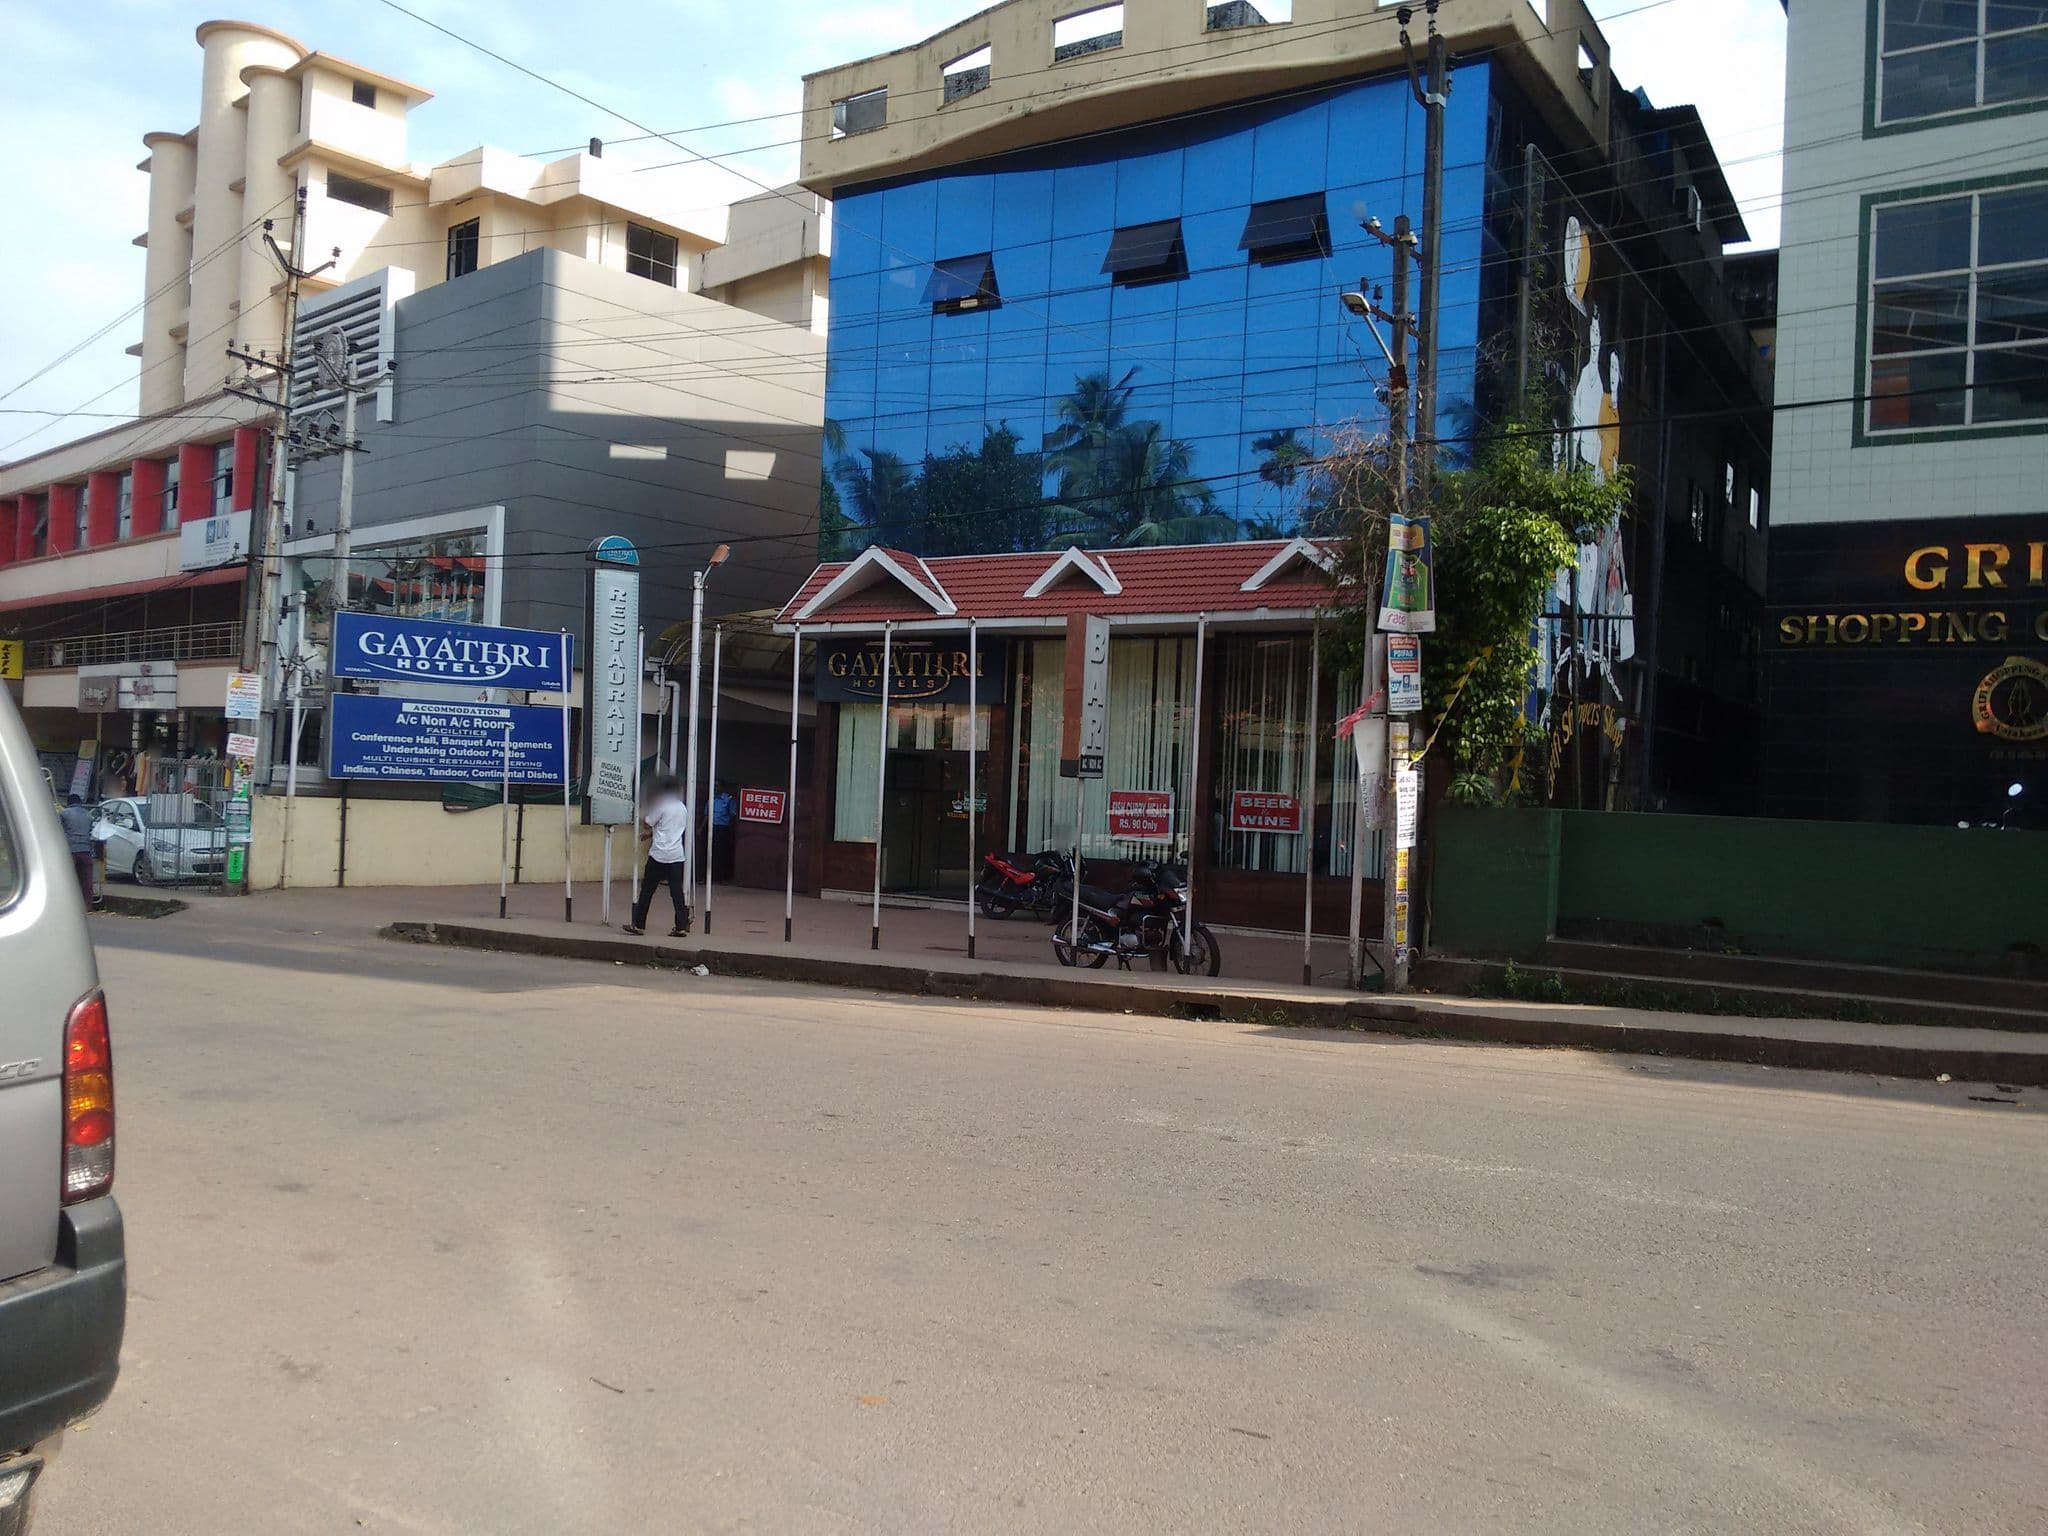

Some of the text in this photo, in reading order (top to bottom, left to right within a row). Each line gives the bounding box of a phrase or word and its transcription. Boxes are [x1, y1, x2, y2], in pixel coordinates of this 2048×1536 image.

[1779, 610, 2010, 645] SHOPPING
[358, 631, 551, 668] GAYATHRI
[397, 658, 497, 675] HOTELS
[606, 585, 627, 752] RESTAURANT
[852, 679, 936, 688] HOELS
[1086, 631, 1107, 750] BAR
[413, 705, 500, 716] ACCOMMODATION
[395, 713, 418, 725] A/c
[421, 715, 446, 726] Non
[449, 716, 470, 728] A/c
[426, 727, 487, 736] FACILITIES
[351, 732, 414, 744] Conference
[416, 735, 439, 746] Hall,
[441, 737, 483, 748] Banquet
[382, 744, 526, 759] Undertaking Outdoor Paties
[362, 755, 543, 768] MULTI CUISINE RESTAURANT ERVING
[342, 764, 379, 775] Indian,
[381, 766, 426, 777] Chinese,
[428, 767, 470, 778] Tandoor,
[527, 770, 558, 780] Dishes
[746, 793, 779, 805] BEER
[1240, 797, 1293, 809] BEER
[745, 807, 777, 818] WINE
[1142, 819, 1158, 832] Only
[1240, 814, 1292, 827] WINE
